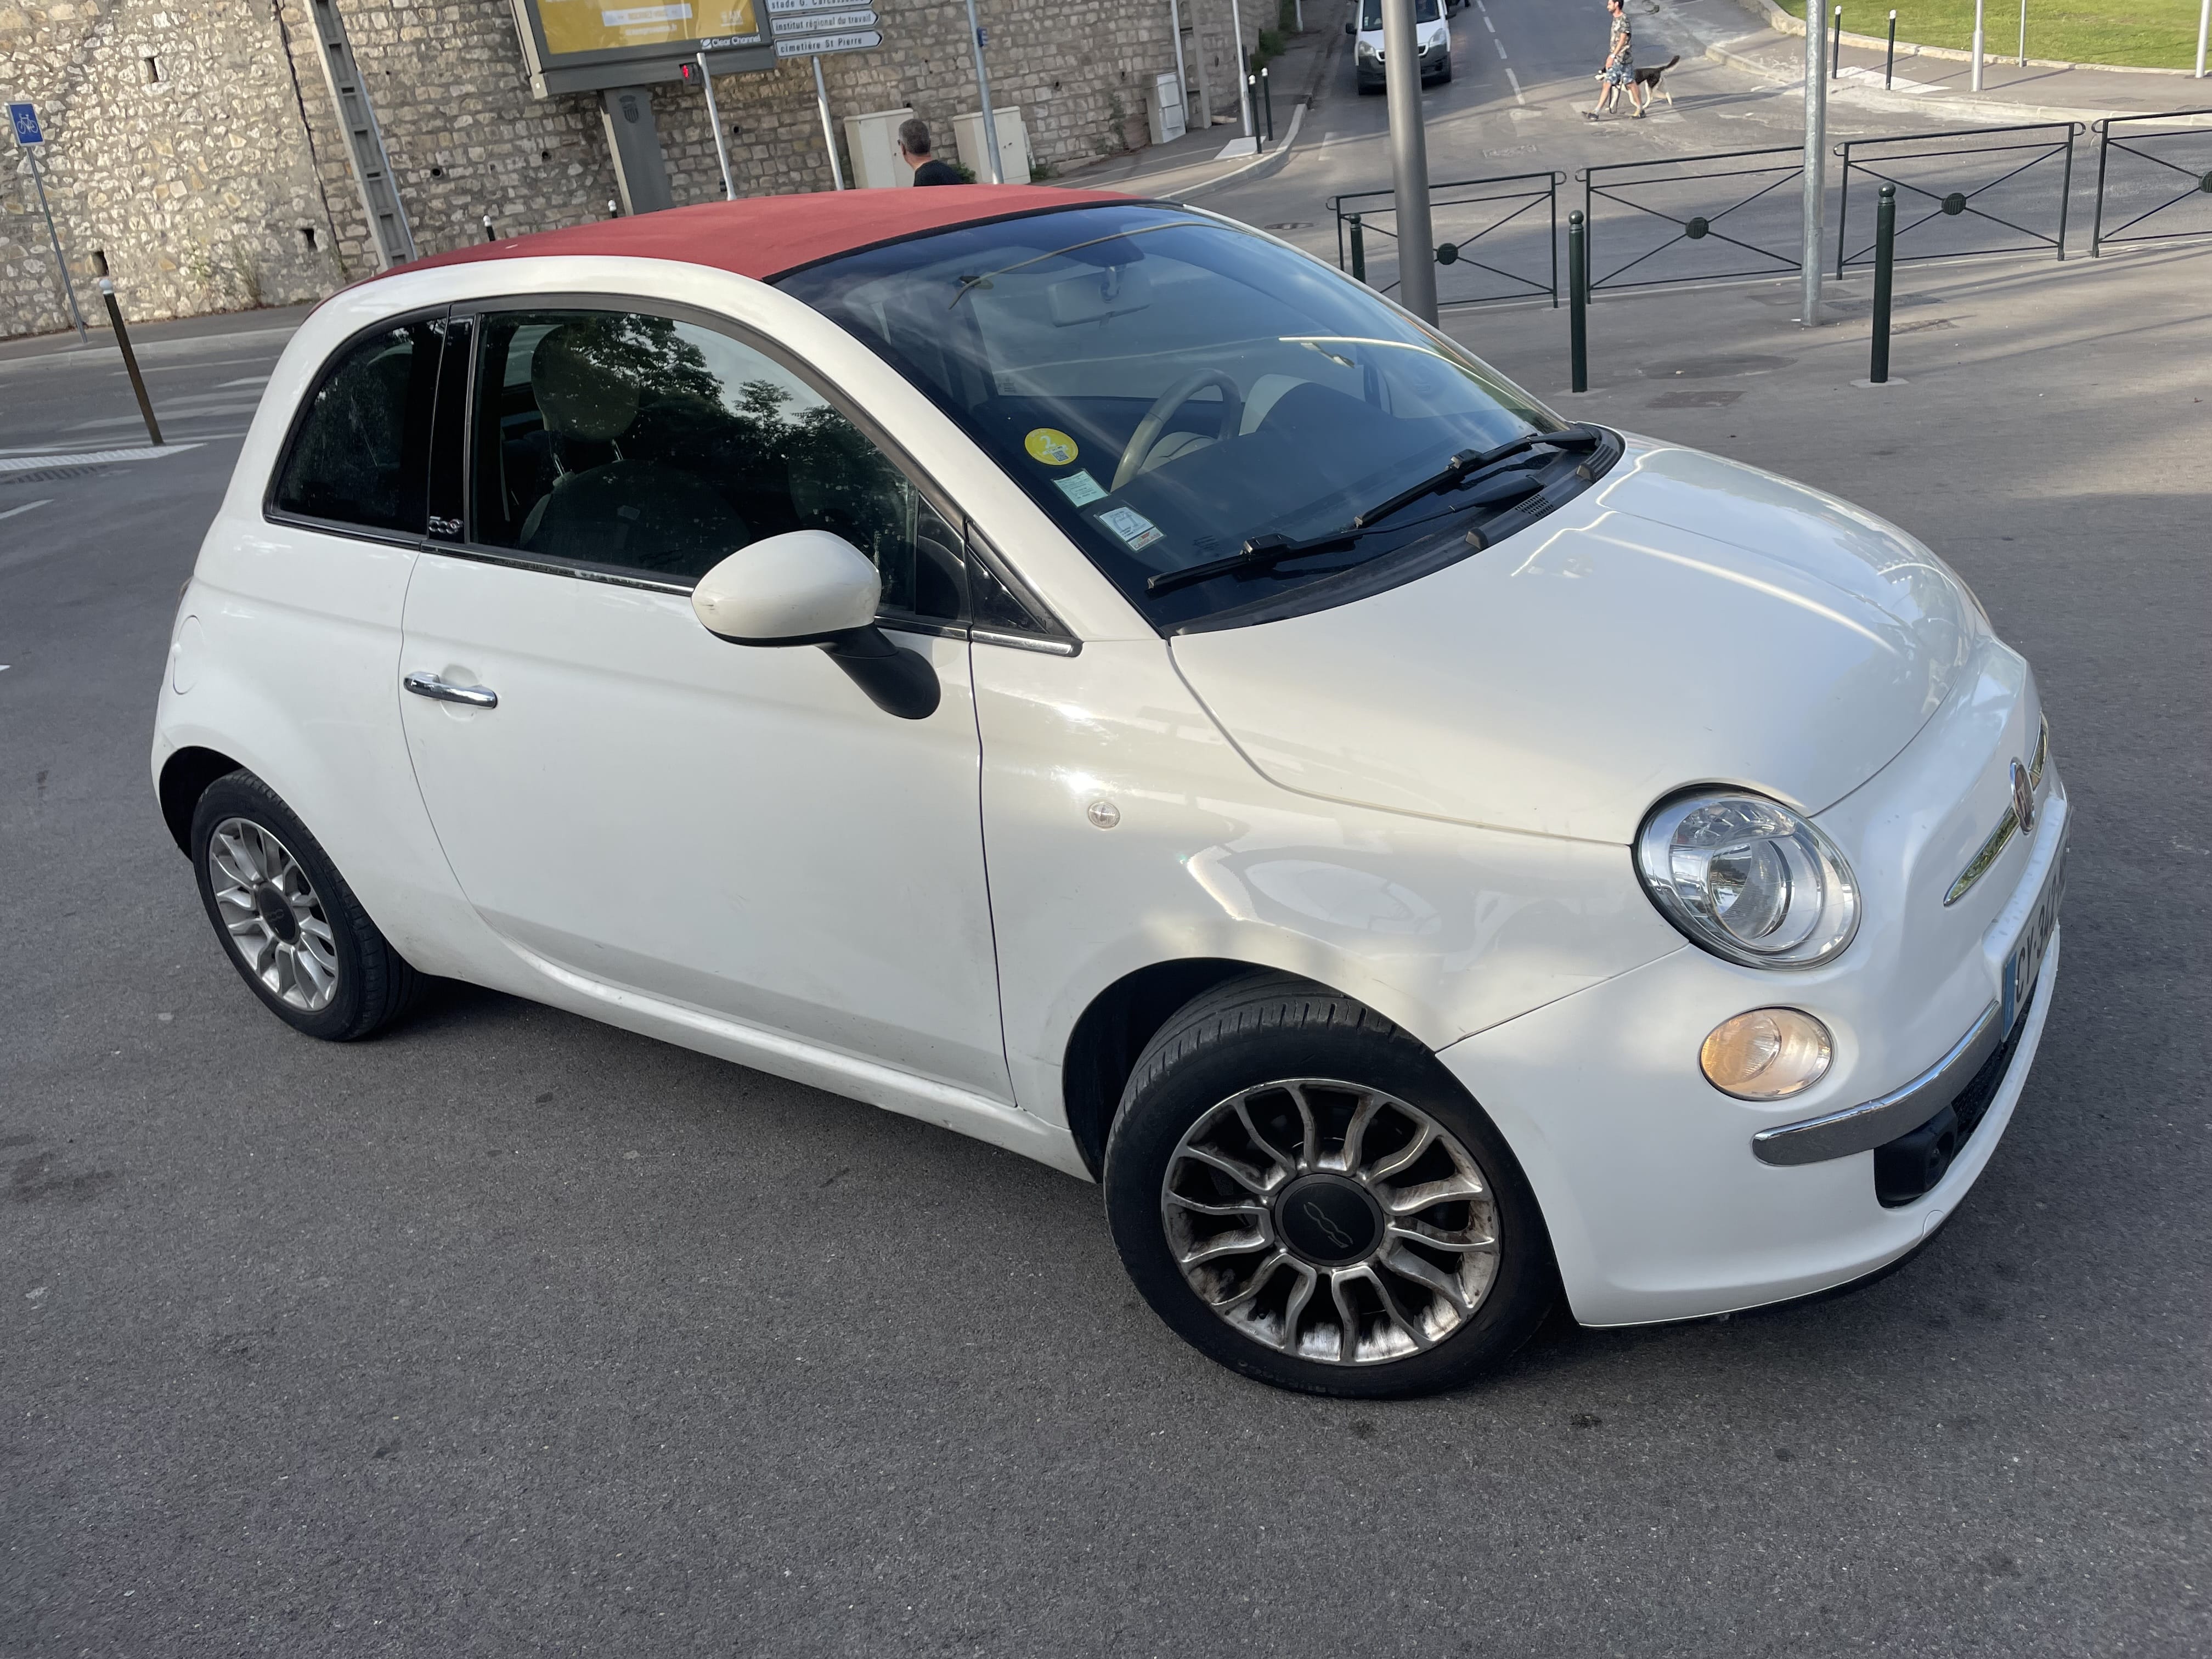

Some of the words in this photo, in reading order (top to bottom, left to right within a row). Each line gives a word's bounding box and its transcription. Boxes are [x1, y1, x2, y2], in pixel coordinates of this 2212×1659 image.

[772, 0, 794, 9] stade
[776, 21, 803, 31] institut
[806, 18, 835, 30] régional
[838, 16, 845, 25] du
[849, 13, 871, 24] travail
[712, 38, 731, 47] Clear
[731, 33, 761, 46] Channel
[781, 41, 821, 53] cimetière
[825, 39, 834, 48] St
[838, 37, 862, 47] Pierre
[1040, 435, 1057, 449] 2
[1133, 532, 1161, 550] CARGLASS
